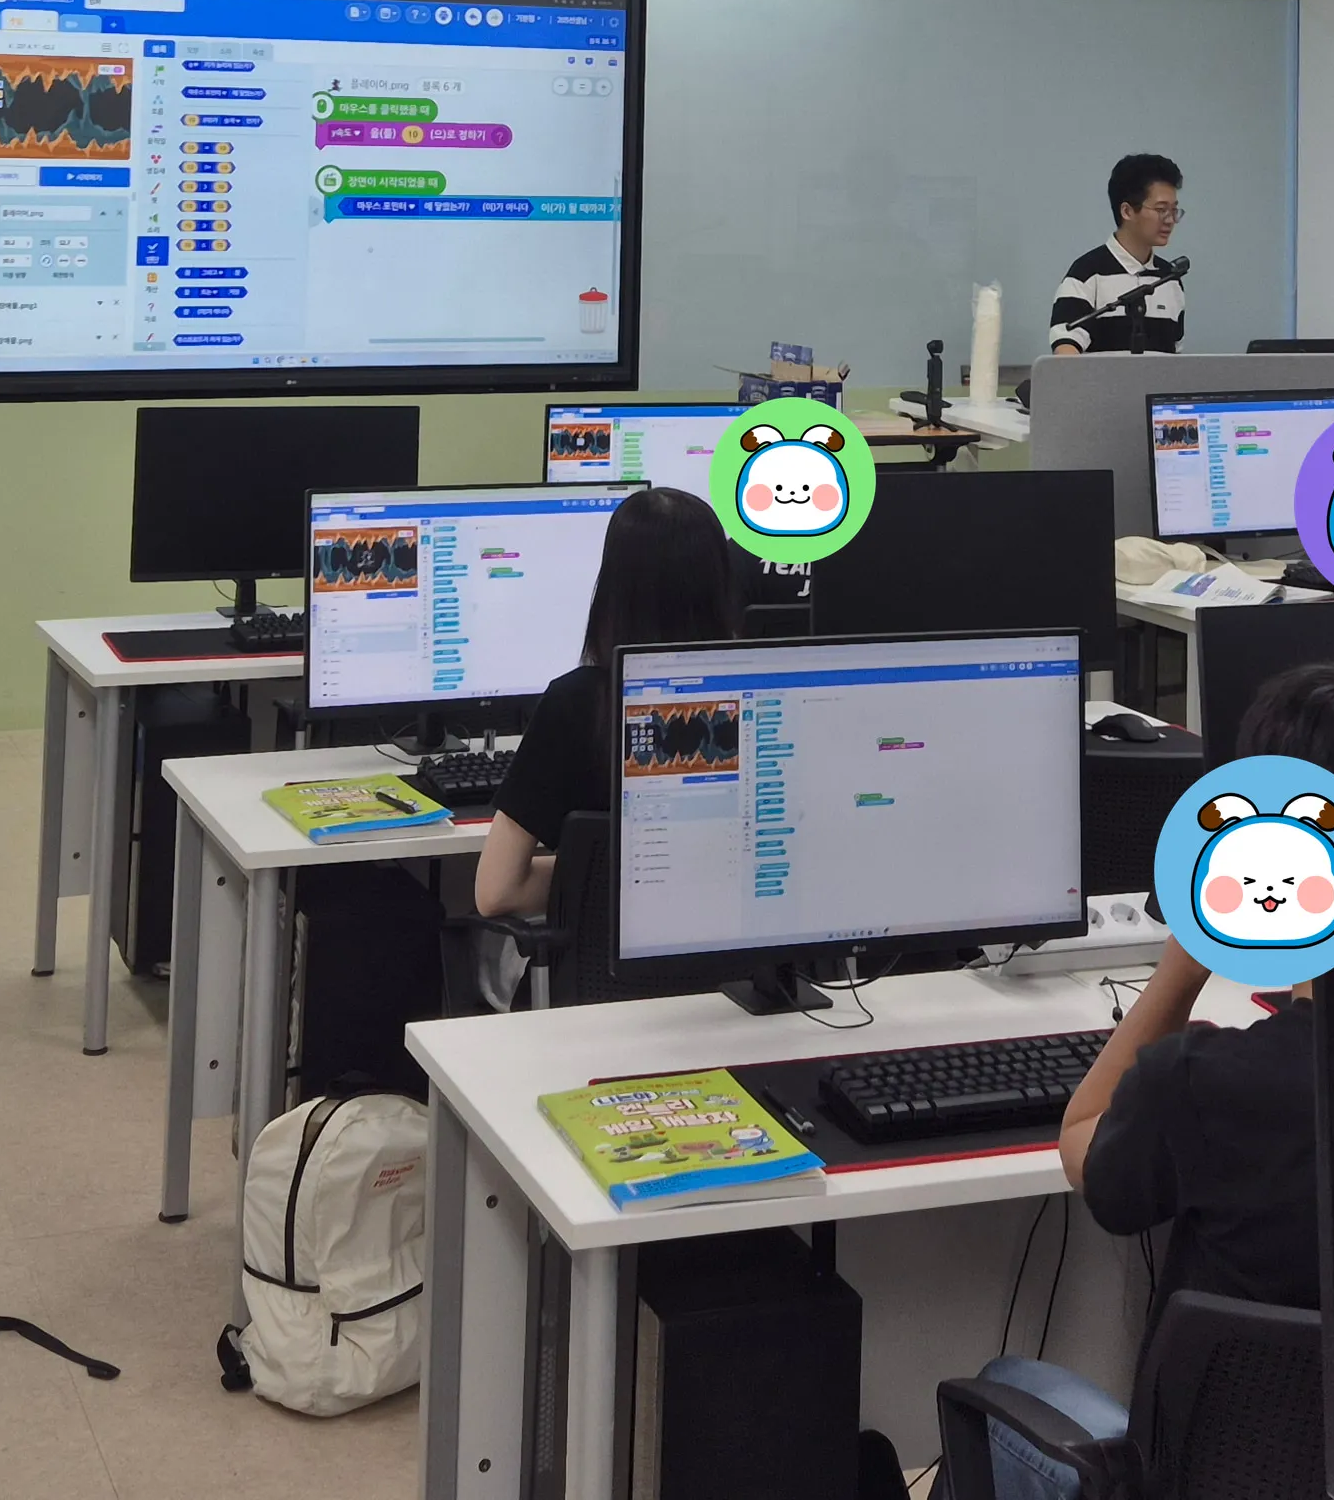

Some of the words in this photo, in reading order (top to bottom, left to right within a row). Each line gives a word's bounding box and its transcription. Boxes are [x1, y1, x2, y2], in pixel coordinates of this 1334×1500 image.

[443, 81, 450, 91] 6
[339, 103, 378, 115] 마우스를
[420, 105, 431, 116] 때
[407, 130, 419, 139] 10
[458, 129, 487, 142] 정하기
[348, 177, 377, 189] 장면이
[428, 177, 439, 189] 때
